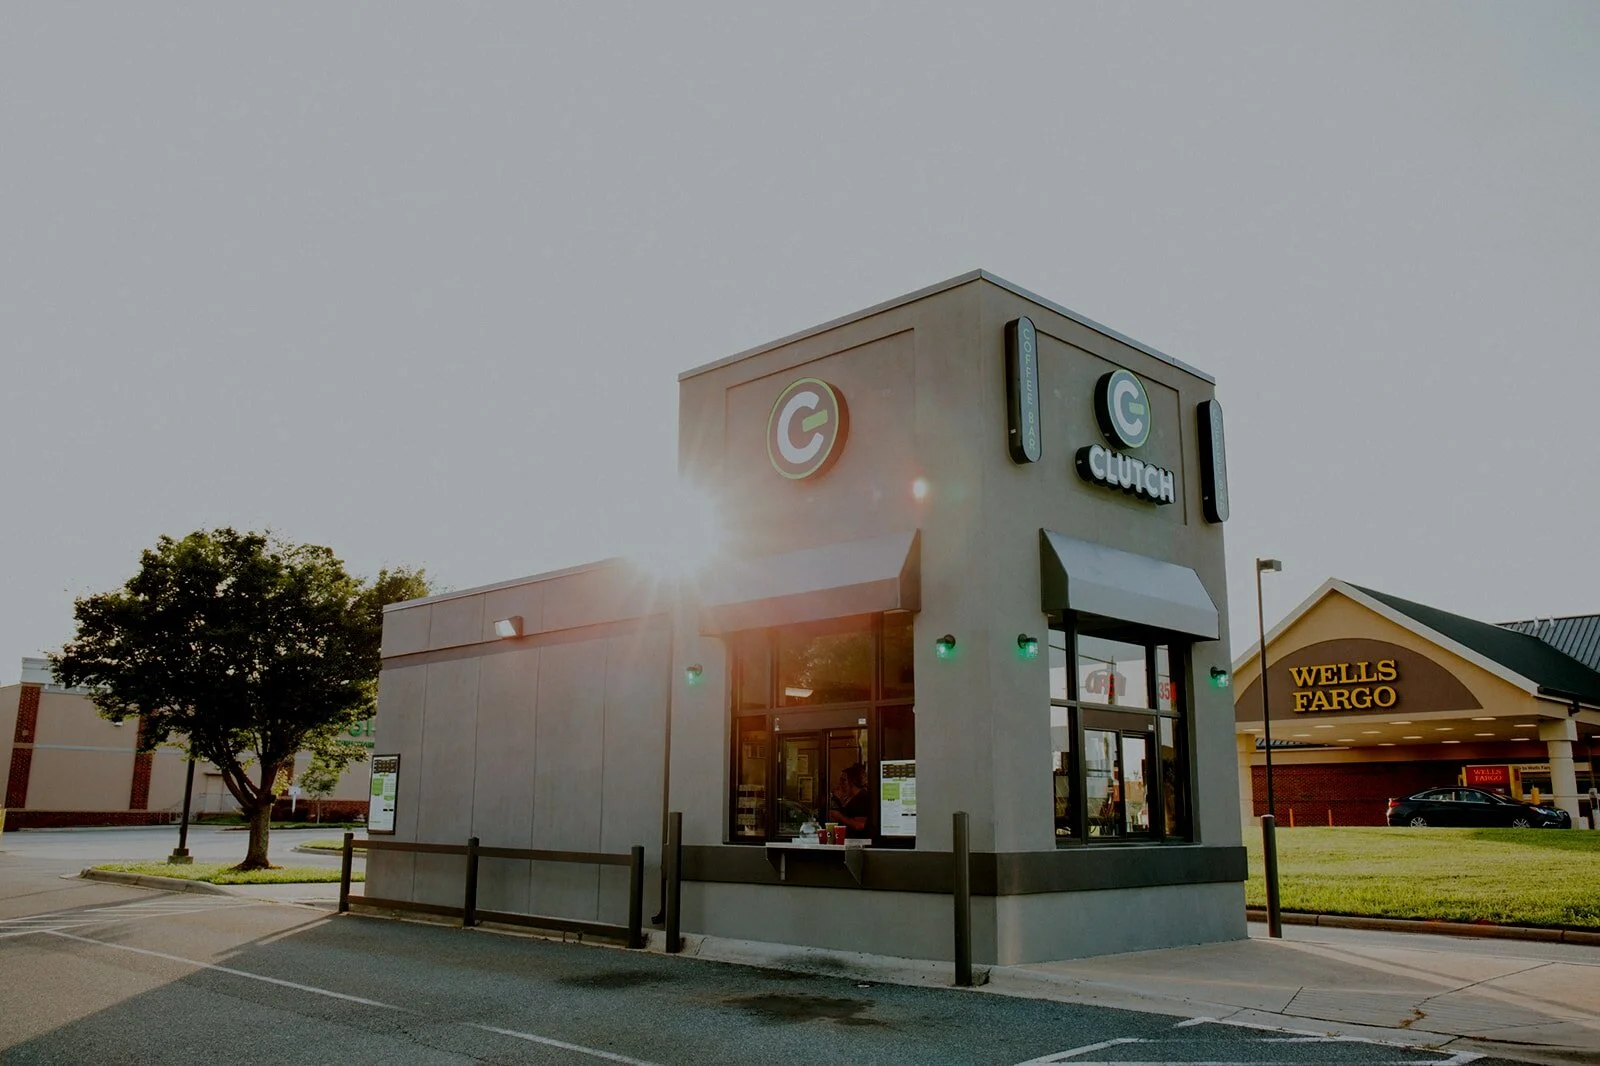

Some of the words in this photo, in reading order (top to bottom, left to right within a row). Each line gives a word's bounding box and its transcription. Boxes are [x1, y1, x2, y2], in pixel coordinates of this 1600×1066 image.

[1022, 327, 1034, 406] COFFEE
[1027, 412, 1037, 452] BAR
[1088, 443, 1175, 504] CLUTCH
[1288, 659, 1398, 687] WELLS
[1292, 685, 1397, 712] FARGO
